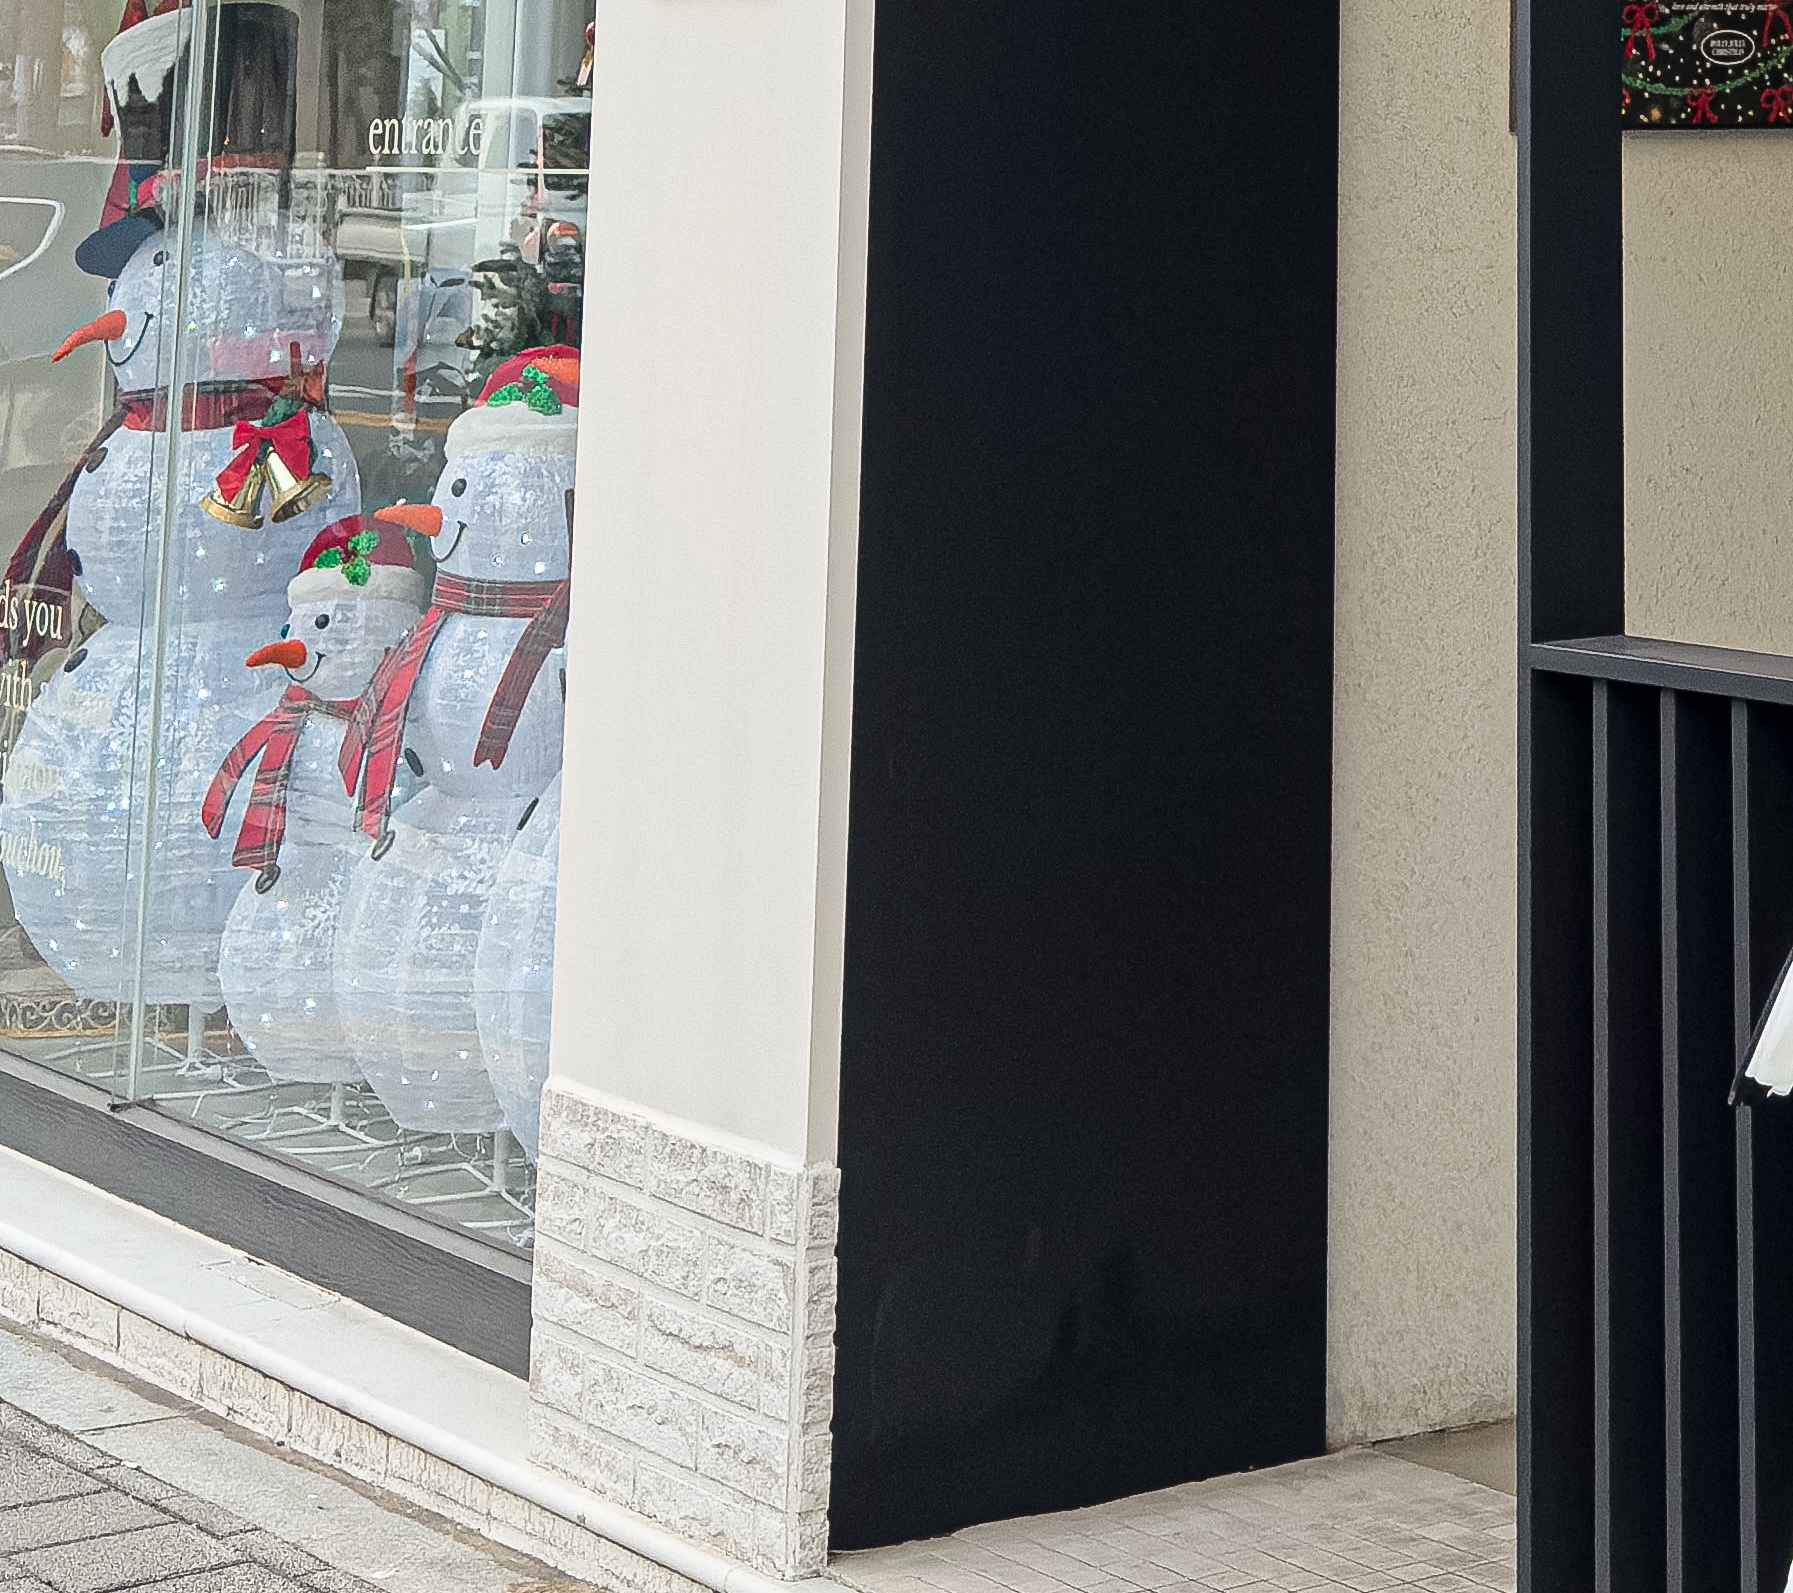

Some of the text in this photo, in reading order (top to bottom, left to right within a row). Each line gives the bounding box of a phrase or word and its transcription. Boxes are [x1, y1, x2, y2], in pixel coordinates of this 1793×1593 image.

[368, 117, 482, 155] entrance
[22, 599, 63, 647] you
[0, 657, 33, 712] ith
